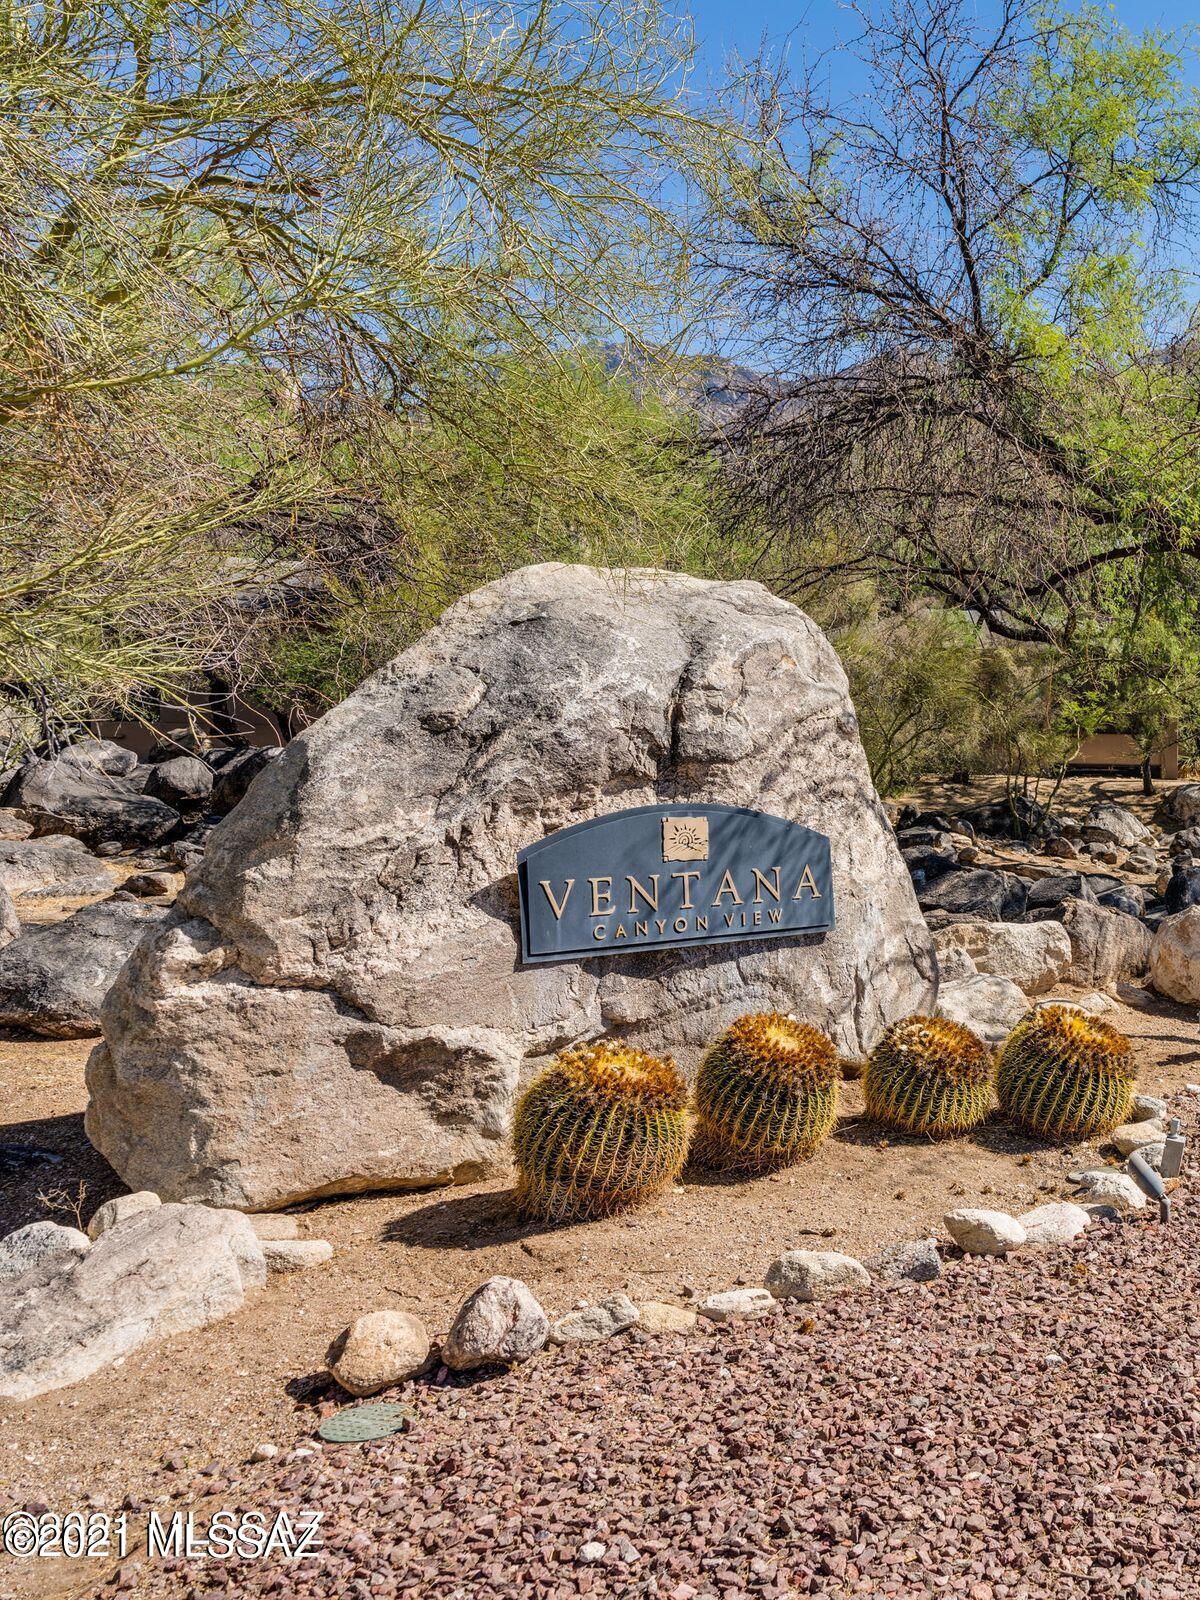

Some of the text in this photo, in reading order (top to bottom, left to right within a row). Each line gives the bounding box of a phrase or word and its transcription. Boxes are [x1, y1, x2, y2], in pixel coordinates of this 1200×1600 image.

[539, 863, 822, 920] VENTANA
[592, 908, 784, 941] CANYON VIEW
